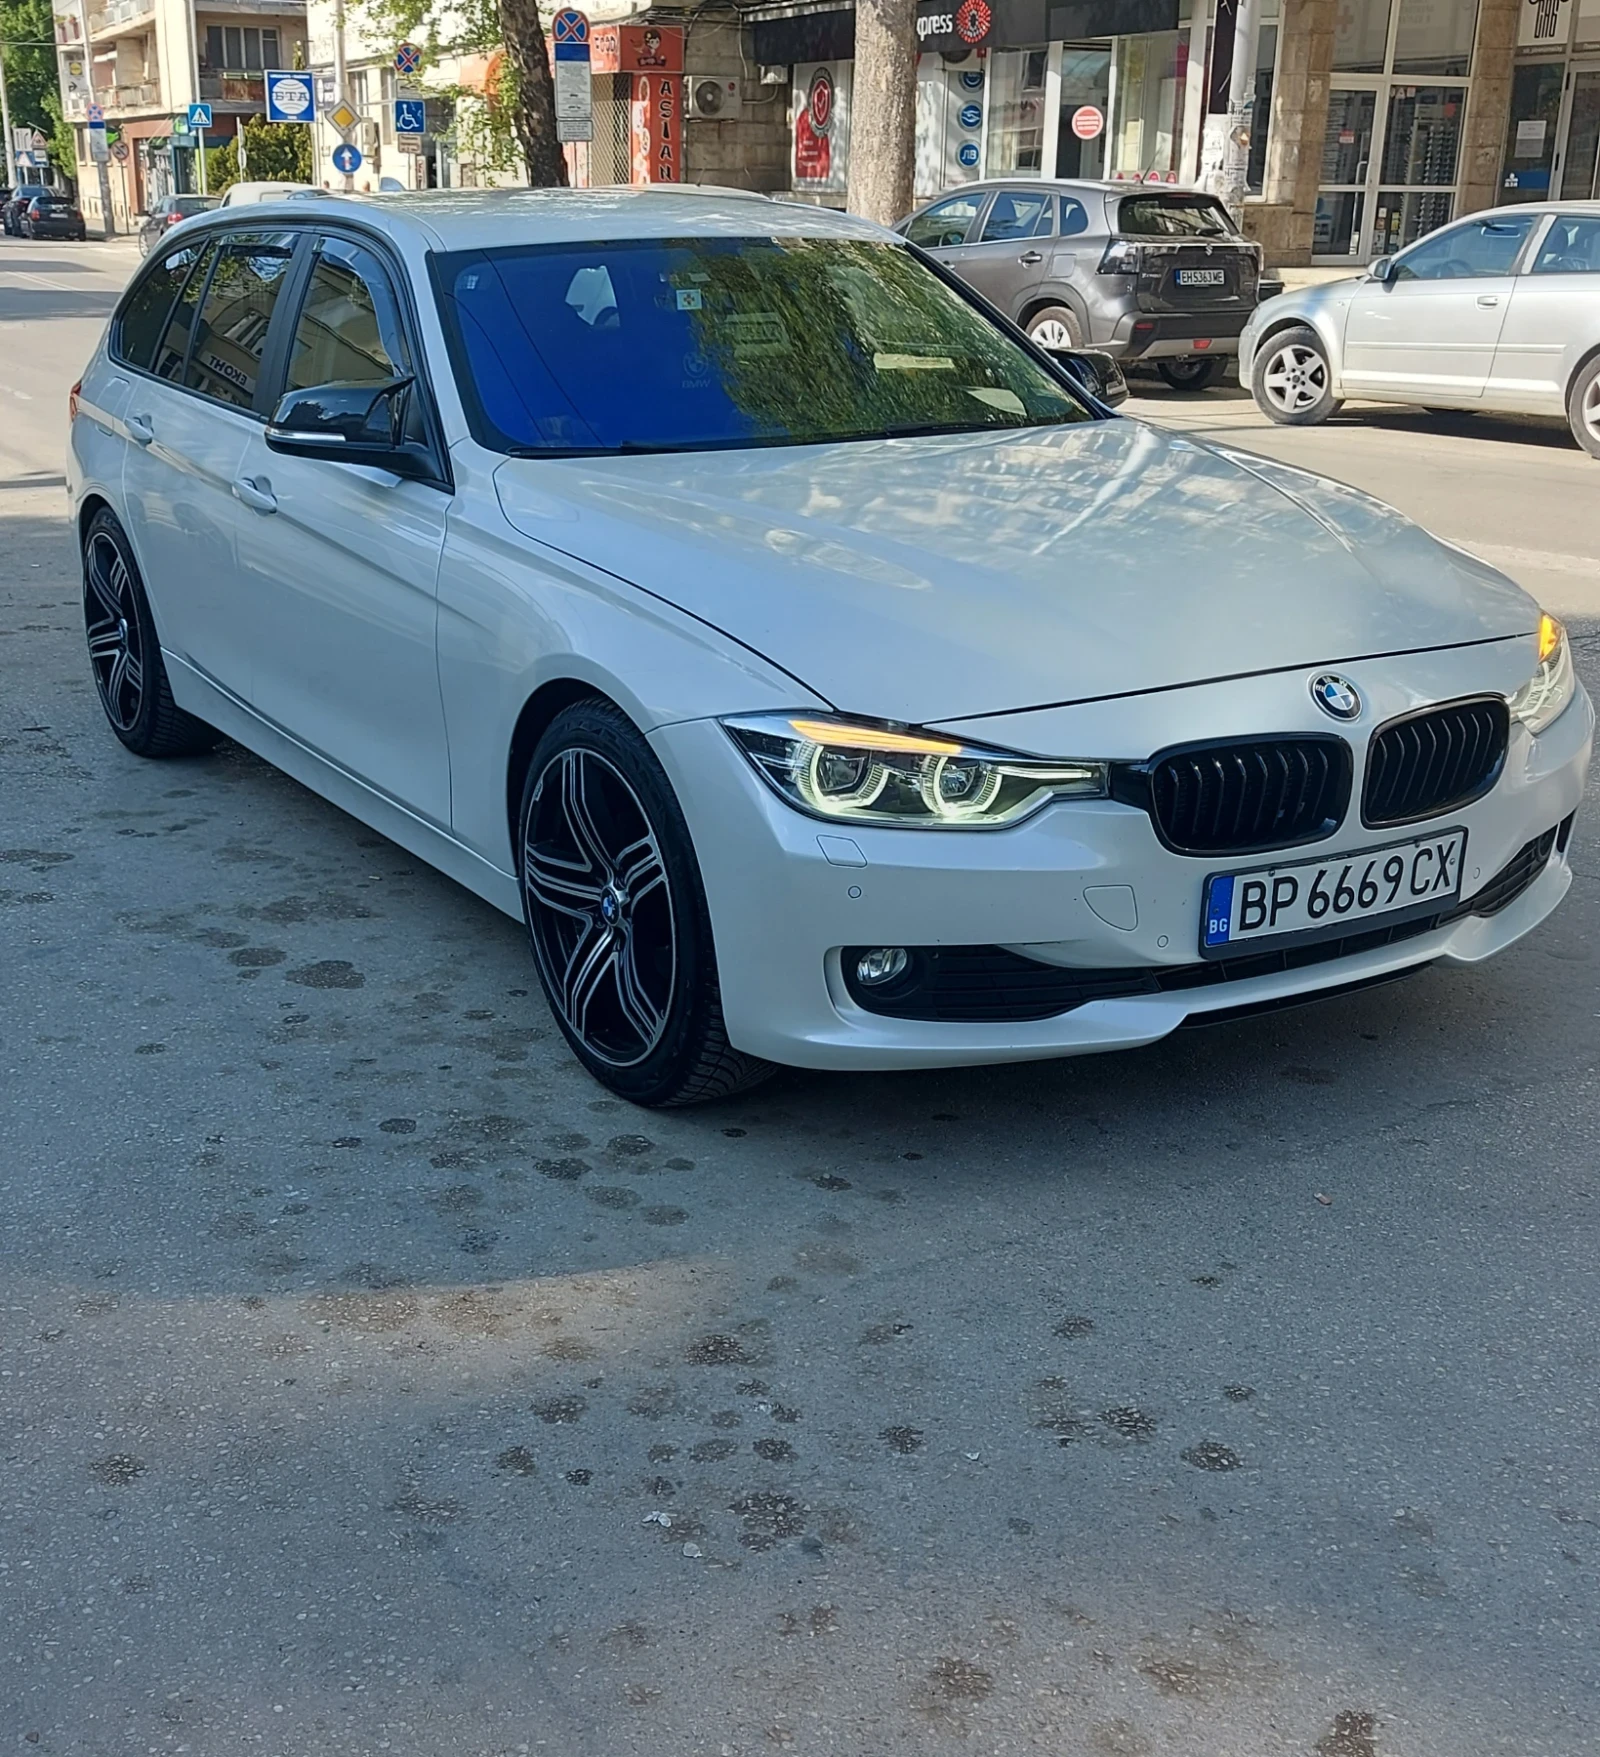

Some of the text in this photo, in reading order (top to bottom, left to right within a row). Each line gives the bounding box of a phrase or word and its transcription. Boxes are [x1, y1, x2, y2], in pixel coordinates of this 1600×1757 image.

[274, 91, 309, 102] БТА
[659, 79, 674, 182] ASIAN
[961, 149, 977, 160] ЛВ
[1208, 917, 1228, 935] BG
